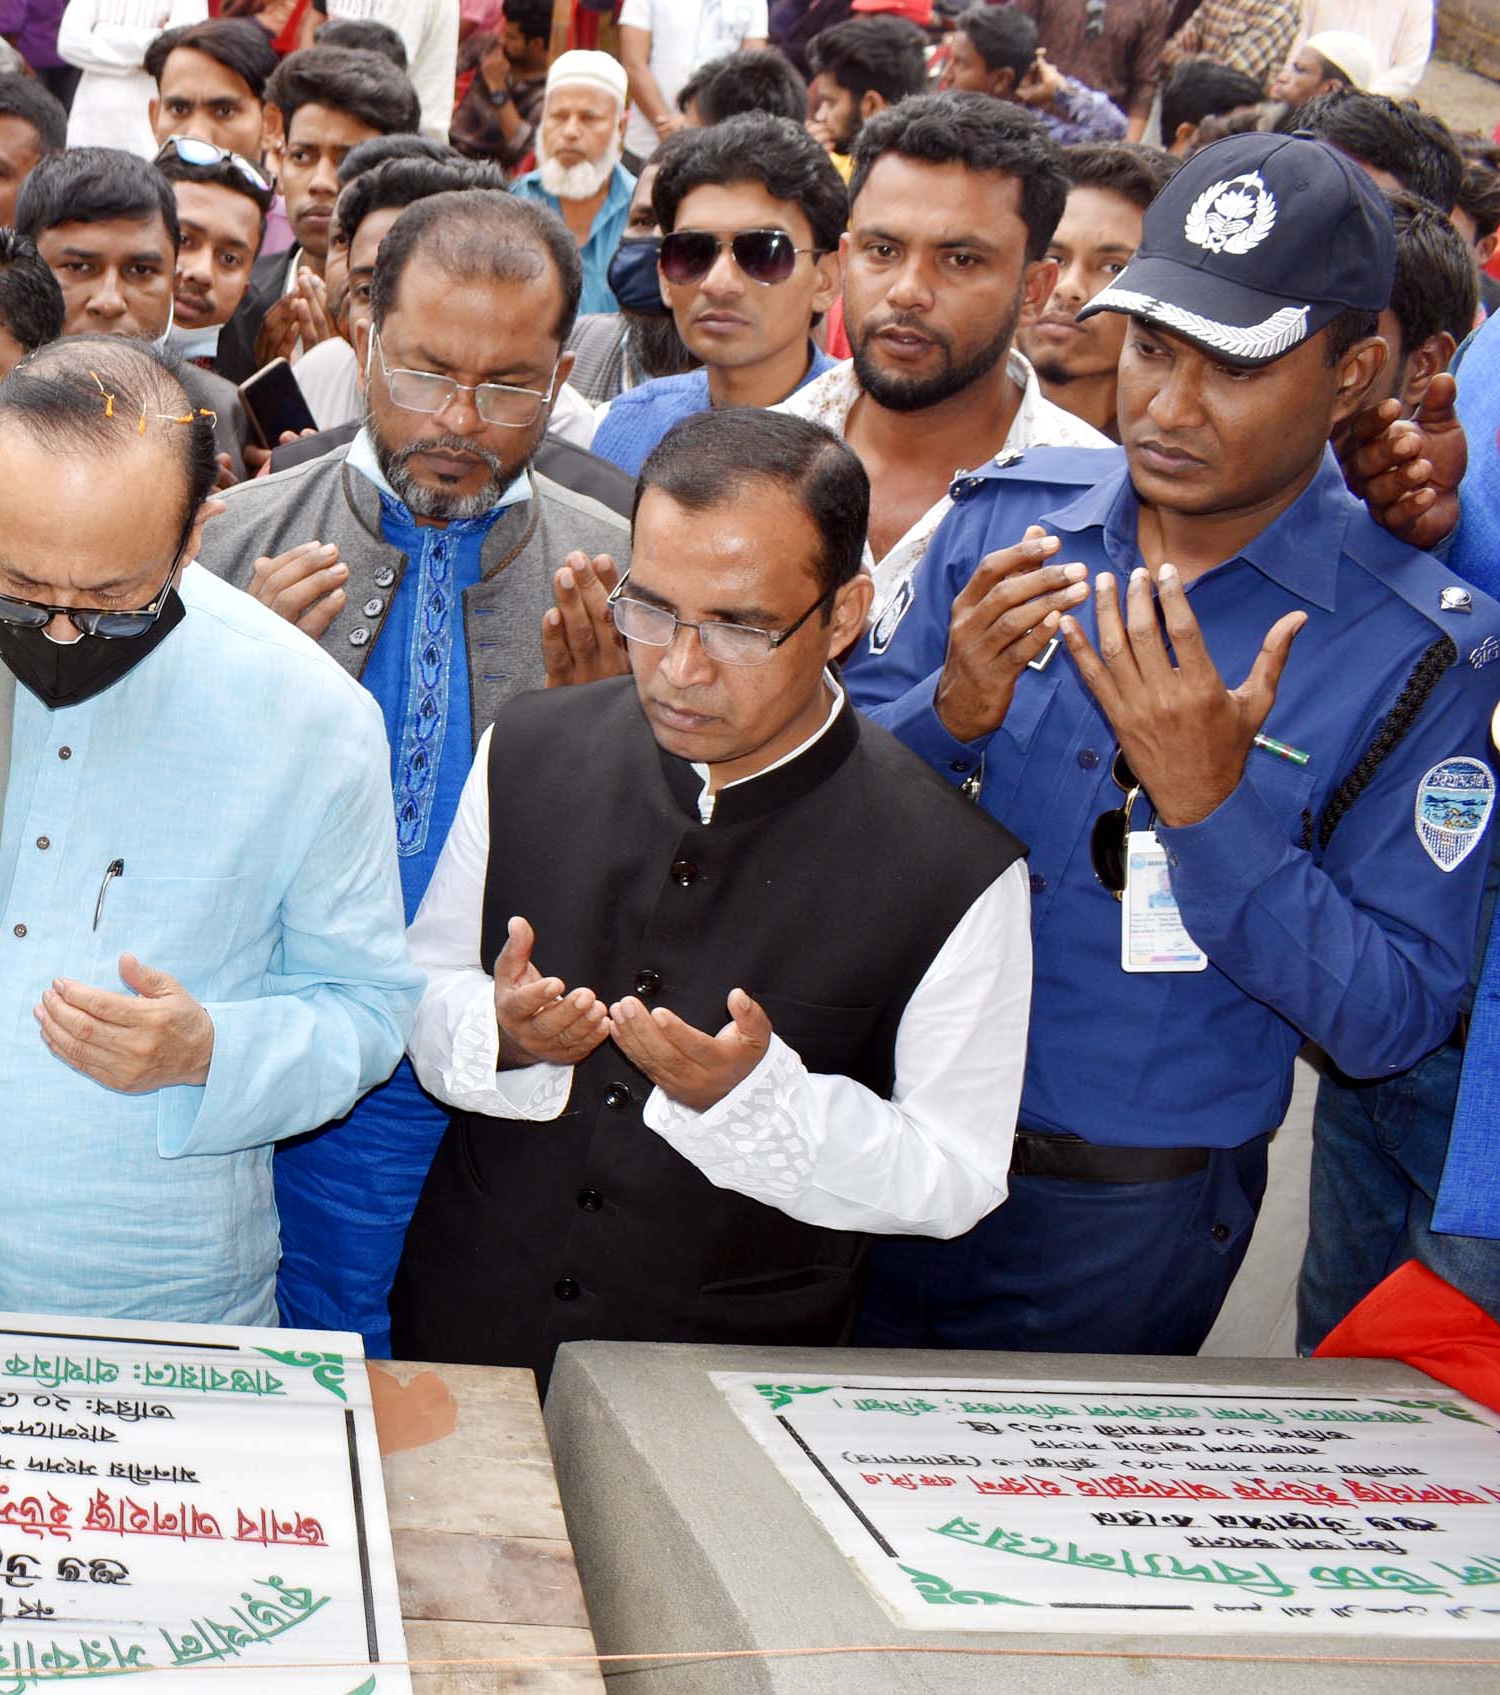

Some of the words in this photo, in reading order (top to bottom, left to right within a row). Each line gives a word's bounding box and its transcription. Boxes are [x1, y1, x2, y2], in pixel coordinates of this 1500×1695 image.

[2, 1353, 120, 1388] প্রাথমিক
[132, 1362, 288, 1397] বাস্তবায়নে:
[32, 1394, 72, 1412] ২০
[84, 1397, 176, 1423] তারিখ:
[1079, 1404, 1200, 1421] প্রকৌশল
[1202, 1406, 1284, 1425] শিক্ষা
[1028, 1439, 1106, 1452] সংসদ
[1201, 1443, 1327, 1455] বাংলাদেশ
[23, 1455, 99, 1477] সংসদ
[107, 1462, 200, 1486] মাননীয়
[1260, 1463, 1336, 1474] সংসদ
[965, 1473, 1073, 1499] হারুন
[1065, 1473, 1232, 1501] আবদুল্লাহ
[1229, 1476, 1359, 1509] ইউসুফ
[1341, 1478, 1492, 1507] আলহাজ্ব
[82, 1487, 224, 1542] আলহাজ্ব
[230, 1506, 329, 1547] জনাব
[1089, 1510, 1207, 1529] করেন
[1208, 1513, 1363, 1536] উদ্বোধন
[1363, 1516, 1447, 1533] শুভ
[1182, 1535, 1285, 1550] ভবনের
[926, 1516, 1299, 1598] বিদ্যালয়ের
[56, 1557, 131, 1586] শুভ
[1308, 1566, 1453, 1599] উচ্চ
[13, 1598, 54, 1622] নব
[158, 1574, 332, 1666] কুড়াখাল
